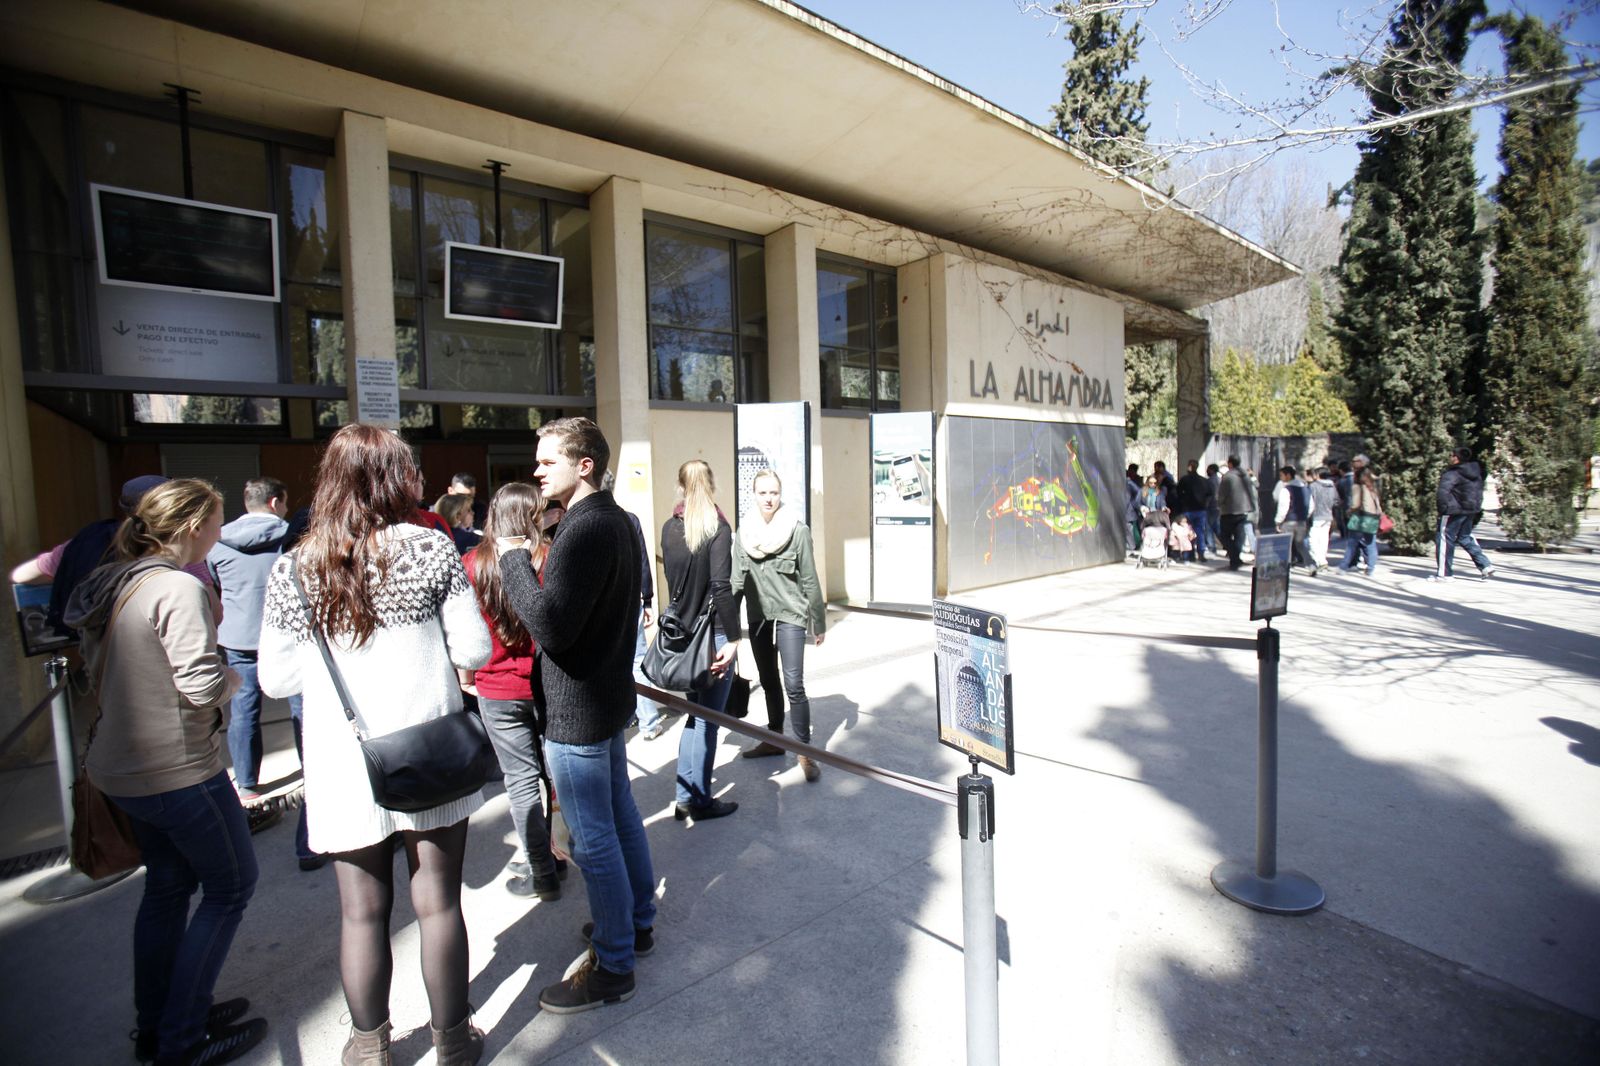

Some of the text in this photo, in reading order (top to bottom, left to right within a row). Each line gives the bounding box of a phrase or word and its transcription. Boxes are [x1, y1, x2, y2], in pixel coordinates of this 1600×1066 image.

[136, 323, 166, 332] VENTA
[168, 326, 204, 335] DIRECTA
[220, 330, 261, 339] ENTRADAS
[137, 333, 218, 345] PAGO EN EFECTIVO
[969, 359, 1114, 411] LA ALHAMBRA
[933, 602, 953, 611] Servicio
[934, 610, 980, 627] AUDIOGUÍAS
[936, 629, 969, 646] Exposición
[937, 641, 964, 657] Temporal
[982, 652, 1005, 673] AL-
[985, 671, 1004, 690] AN
[988, 687, 1005, 708] DA
[980, 702, 1005, 728] LUS
